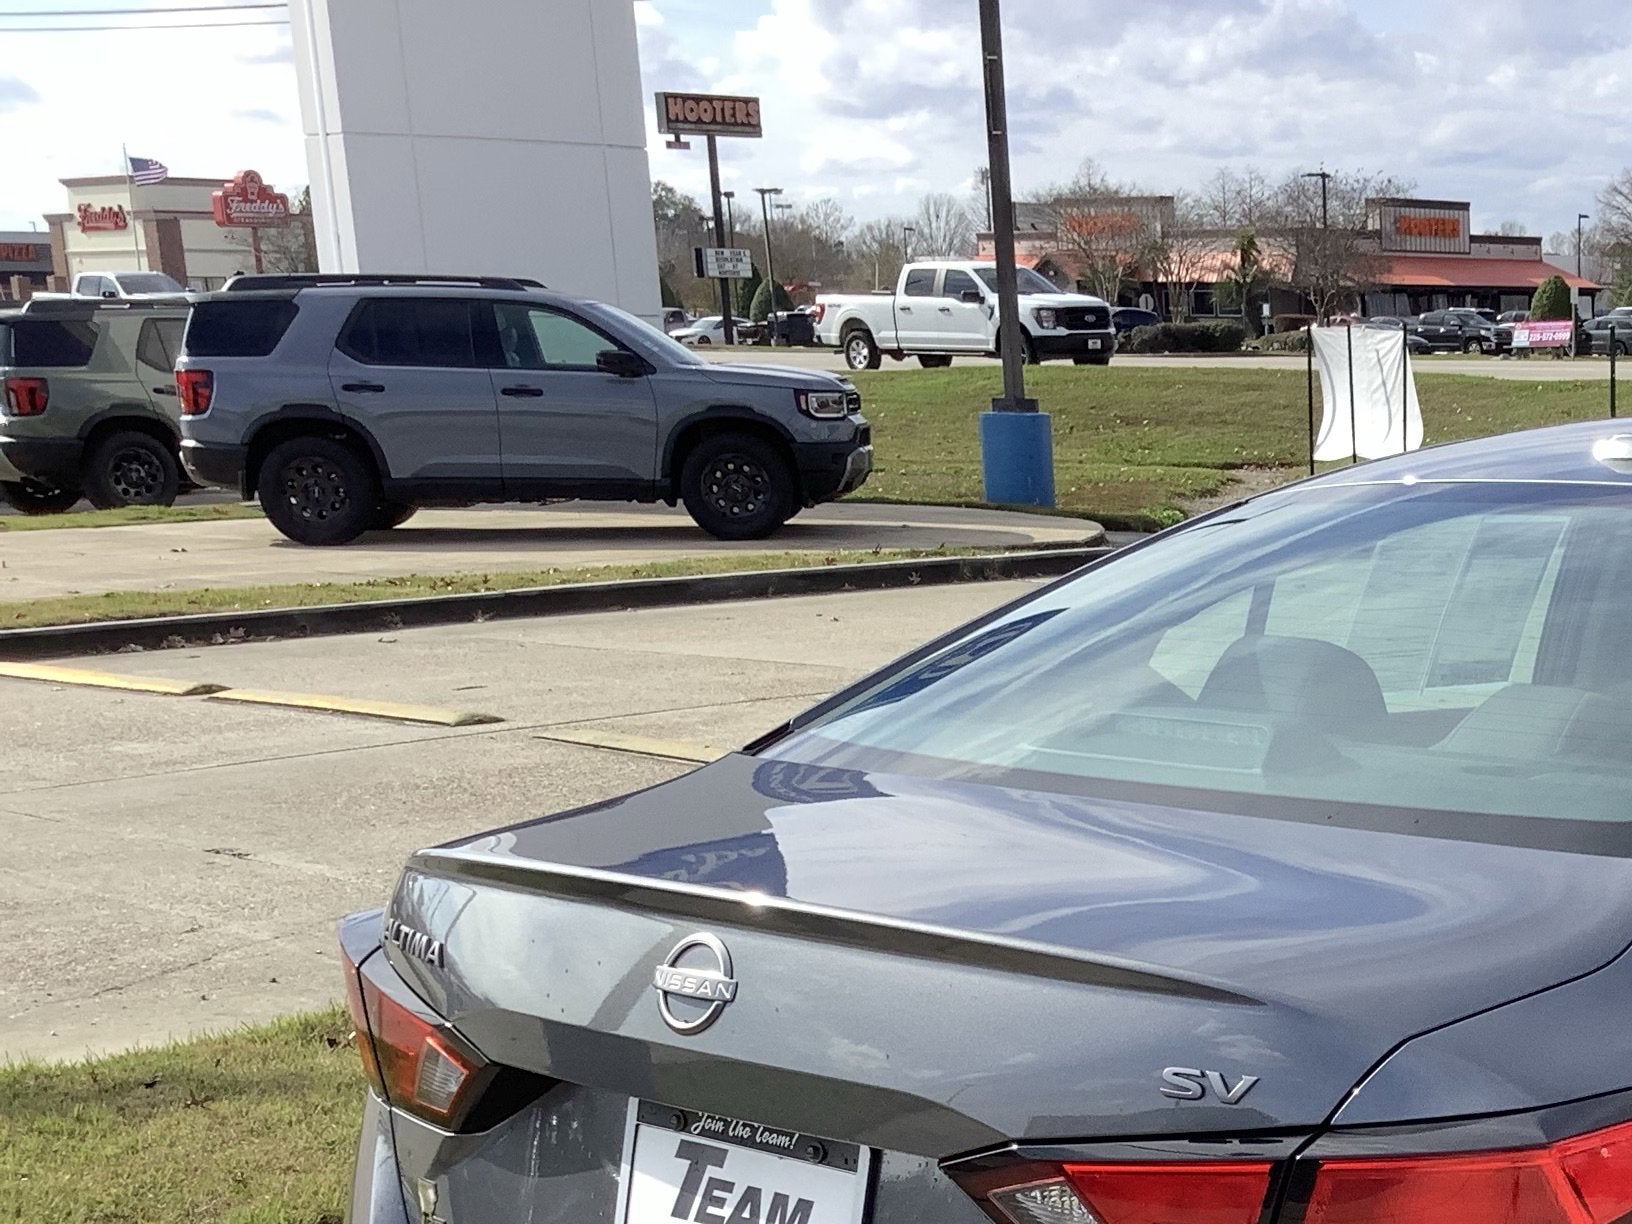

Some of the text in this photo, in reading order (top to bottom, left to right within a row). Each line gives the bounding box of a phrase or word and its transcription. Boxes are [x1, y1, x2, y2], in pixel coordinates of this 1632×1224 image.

[667, 97, 760, 125] HOOTERS
[227, 196, 286, 217] Freddy's
[655, 969, 733, 999] NISSAN
[1160, 1066, 1259, 1105] SV
[690, 1111, 725, 1135] Join
